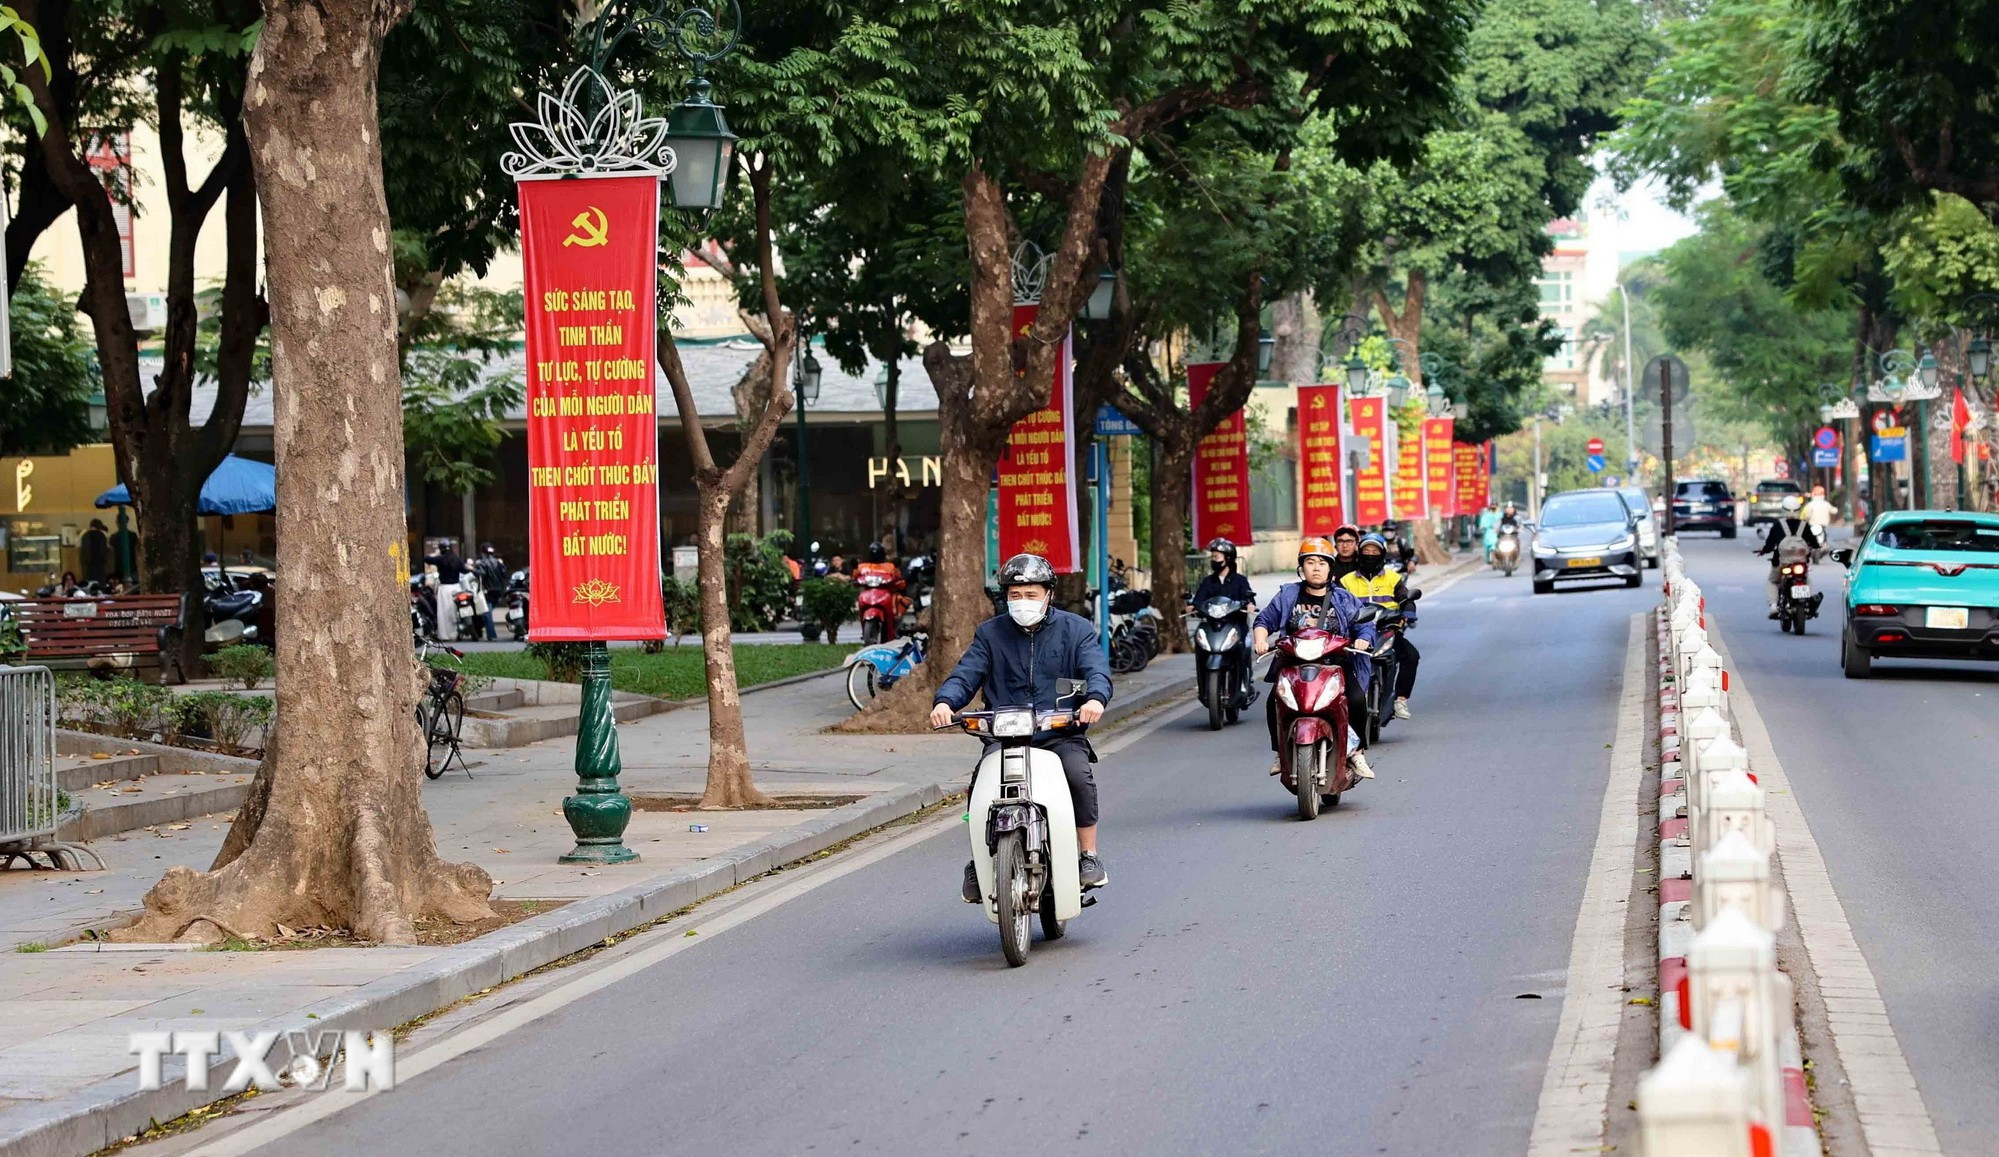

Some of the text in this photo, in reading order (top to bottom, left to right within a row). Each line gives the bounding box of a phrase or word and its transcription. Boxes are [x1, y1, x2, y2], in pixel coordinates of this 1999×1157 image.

[544, 287, 636, 314] SỨC SÁNG TẠO,
[559, 318, 622, 346] TINH THẦN
[538, 355, 645, 386] TỰ LỰC, TỰ CƯỜNG
[533, 389, 653, 417] CỦA MỖI NGƯỜI DÂN
[563, 422, 622, 452] LÀ YẾU TỐ
[532, 456, 656, 487] THEN CHỐT THÚC ĐẨY
[560, 492, 630, 522] PHÁT TRIỂN
[563, 530, 626, 556] ĐẤT NƯỚC!
